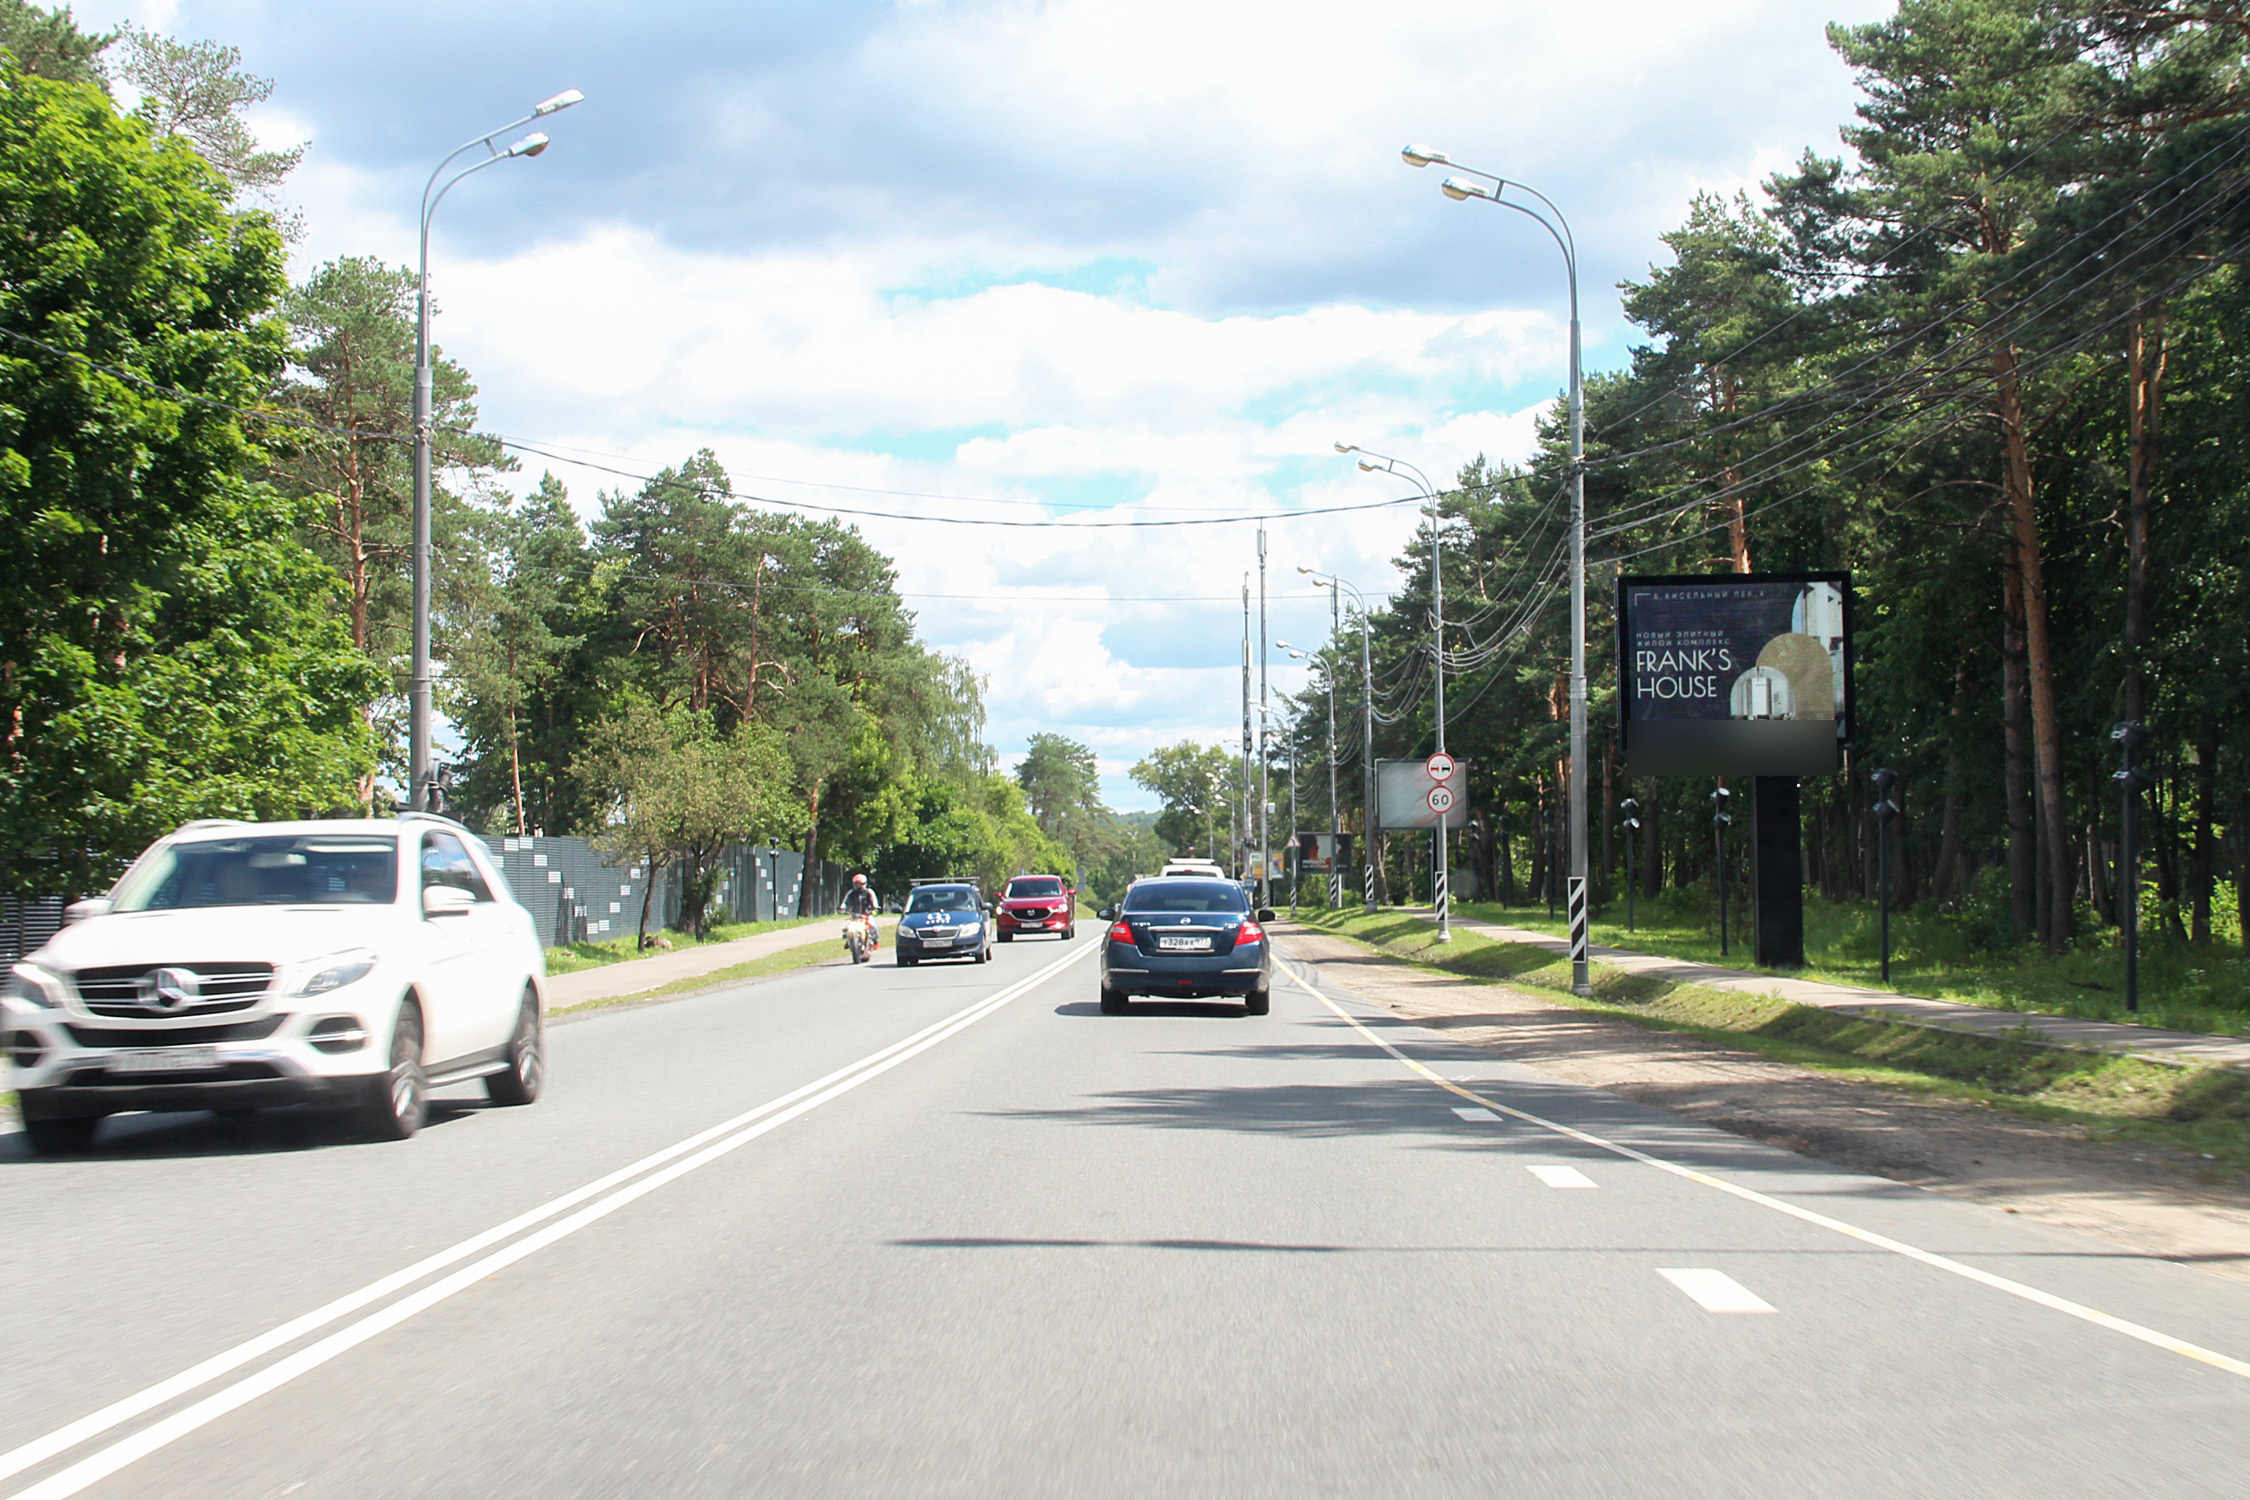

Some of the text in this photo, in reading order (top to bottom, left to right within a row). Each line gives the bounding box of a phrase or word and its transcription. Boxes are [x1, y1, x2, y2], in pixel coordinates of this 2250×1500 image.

[1636, 630, 1723, 639] НОВЫЙ ЭЛИТНЫЙ
[1636, 639, 1730, 647] ЖИЛОЙ КОМПЛЕКС
[1636, 648, 1732, 672] FRANK'S
[1637, 675, 1717, 699] HOUSE
[1432, 794, 1449, 805] 60
